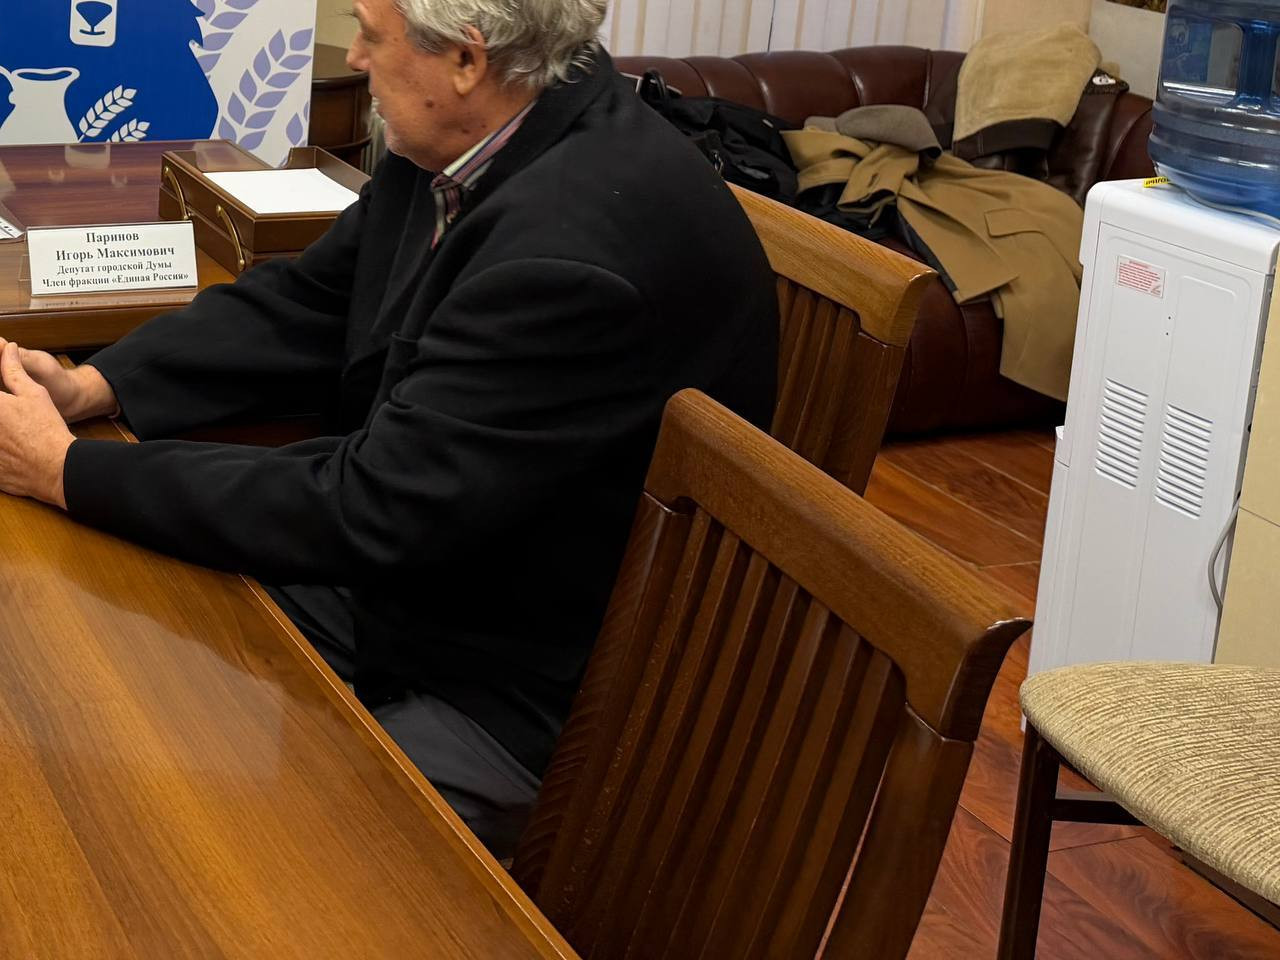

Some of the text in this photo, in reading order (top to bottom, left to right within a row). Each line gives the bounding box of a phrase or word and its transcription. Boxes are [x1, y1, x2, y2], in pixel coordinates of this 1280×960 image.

[86, 232, 140, 245] Паринов
[56, 247, 175, 263] Игорь Максимович
[56, 261, 172, 276] Депутат городской Думы
[42, 271, 189, 288] Член фракции «Единая Россия»
